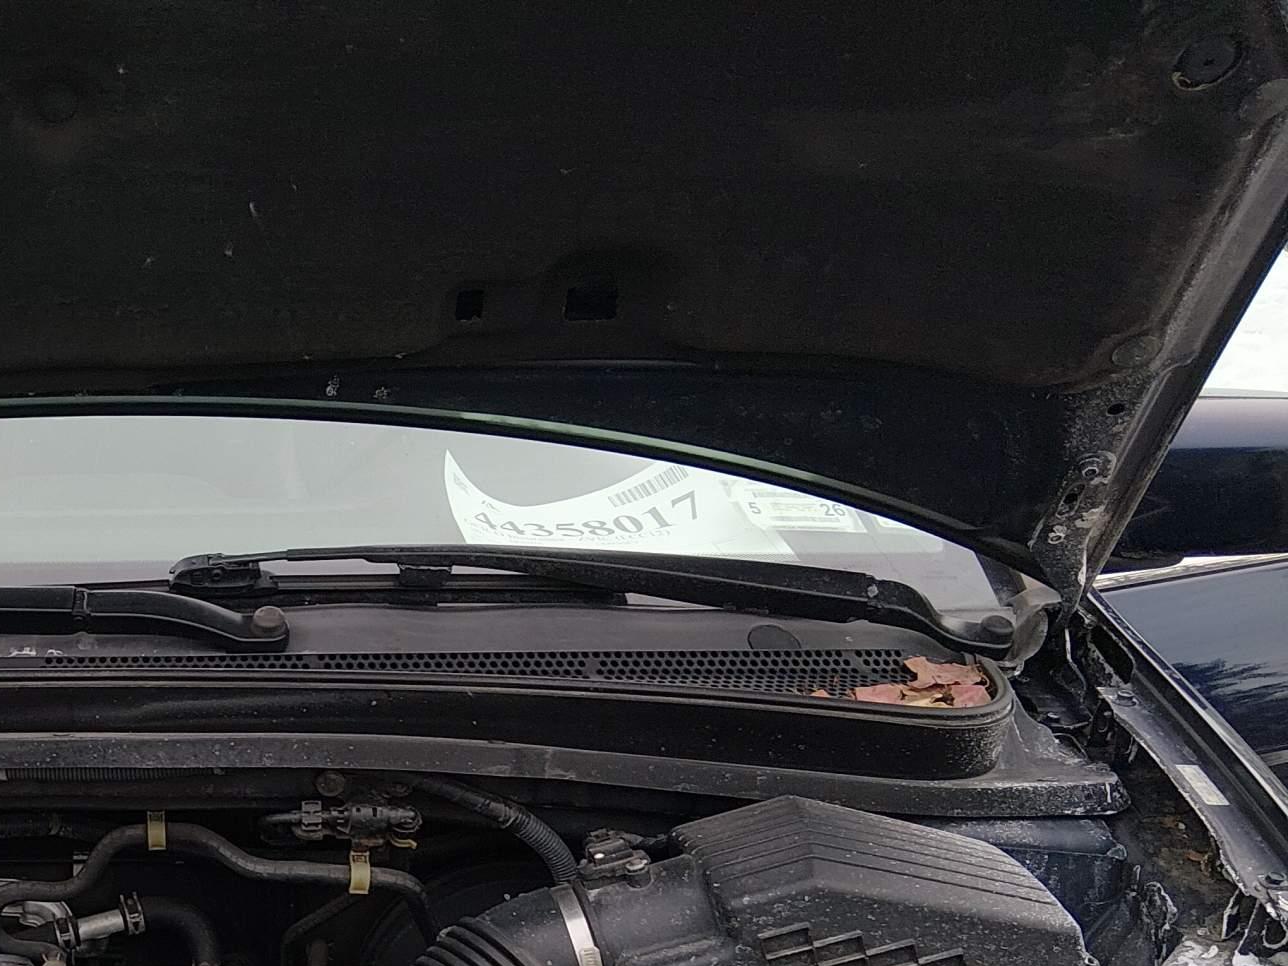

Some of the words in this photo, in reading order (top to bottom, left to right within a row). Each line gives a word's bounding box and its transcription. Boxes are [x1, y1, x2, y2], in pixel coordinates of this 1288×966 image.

[473, 489, 700, 537] 44358017
[748, 501, 762, 515] 5
[819, 502, 846, 517] 26
